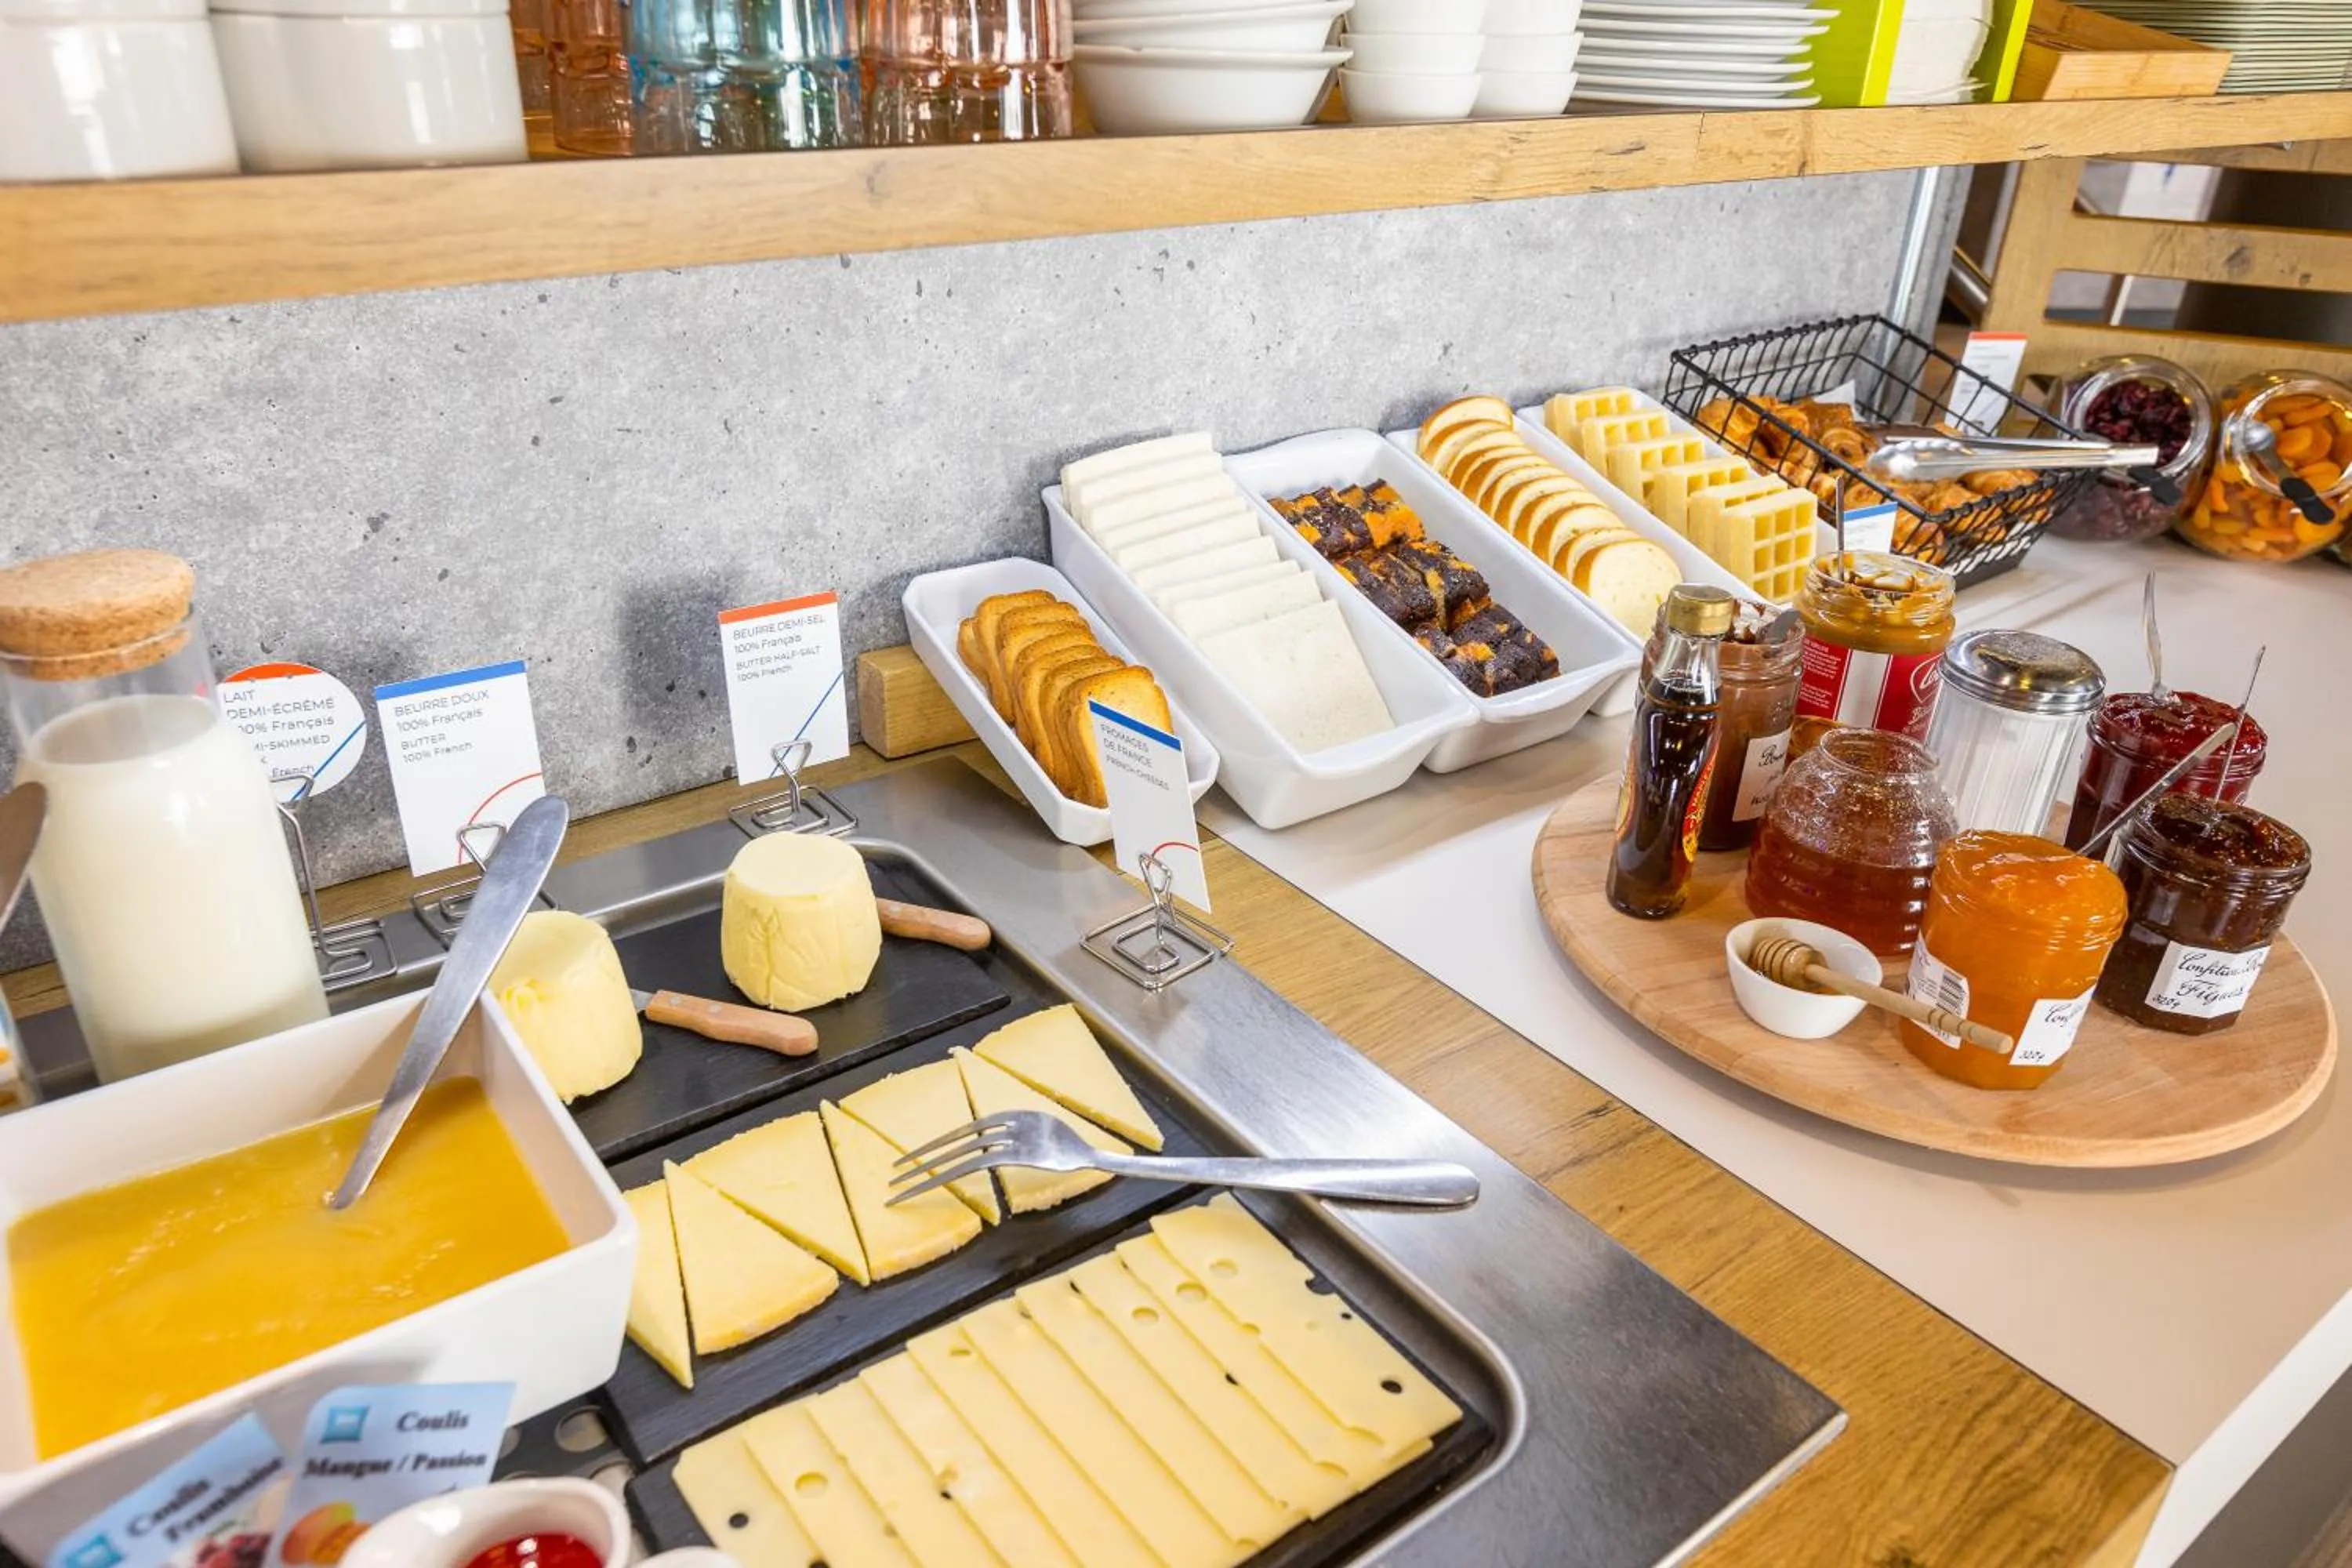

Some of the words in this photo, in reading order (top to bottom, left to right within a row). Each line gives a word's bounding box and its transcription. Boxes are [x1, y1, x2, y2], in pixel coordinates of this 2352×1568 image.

[733, 623, 776, 640] BEURRE
[777, 615, 826, 631] DEMI-SEL
[734, 642, 760, 653] 100%
[761, 633, 803, 648] Français
[736, 656, 772, 670] BUTTER
[223, 690, 256, 703] LAIT
[394, 697, 449, 717] BEURRE
[451, 690, 489, 706] DOUX
[227, 698, 336, 719] DEMI-ÉCRÉMÉ
[271, 717, 335, 731] Français
[397, 718, 430, 733] 100%
[432, 709, 484, 723] Français
[401, 733, 446, 750] BUTTER
[403, 751, 431, 763] 100%
[434, 742, 473, 755] French
[271, 764, 314, 778] French
[396, 1410, 470, 1432] Coulis
[303, 1456, 393, 1480] Mangue
[412, 1451, 488, 1472] Passion
